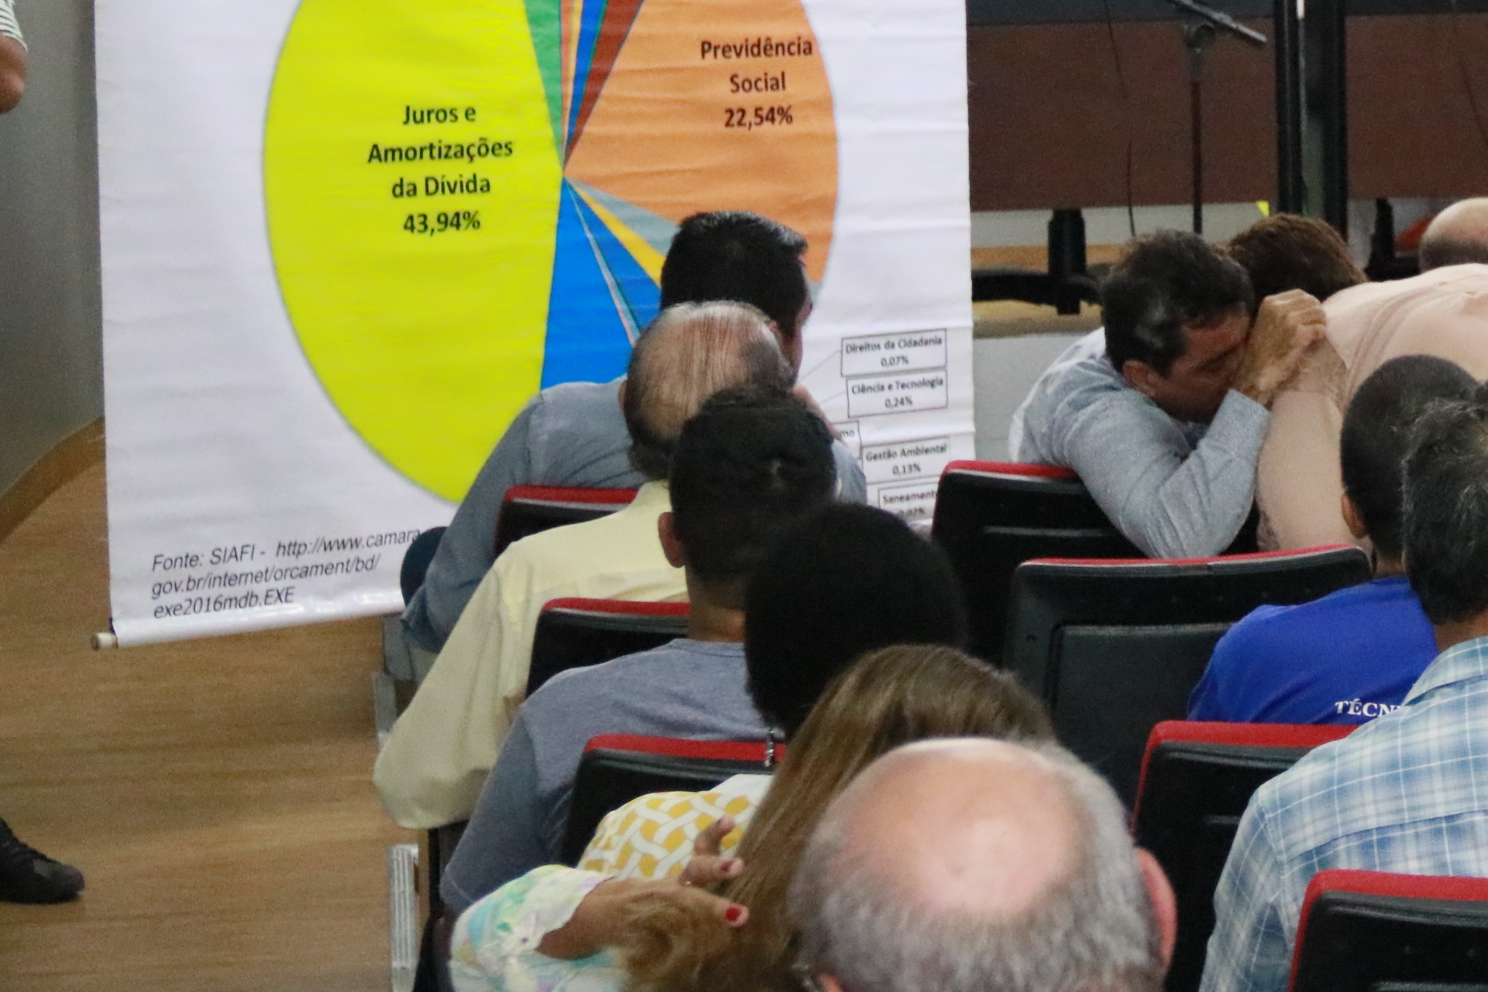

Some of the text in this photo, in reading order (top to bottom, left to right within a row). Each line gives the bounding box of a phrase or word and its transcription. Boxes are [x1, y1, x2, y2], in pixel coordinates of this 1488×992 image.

[700, 36, 813, 60] Previdência
[729, 71, 786, 94] Social
[402, 105, 476, 126] Juros e
[724, 106, 793, 130] 22,54%
[367, 138, 513, 165] Amortizações
[391, 174, 491, 198] da Dívida
[403, 211, 481, 236] 43,94%
[845, 336, 943, 355] Direitos da Cidadania
[880, 355, 910, 367] 0,07%
[851, 377, 944, 395] Ciência e Tecnologia
[885, 395, 913, 409] 0,24%
[865, 443, 947, 462] Gestão Ambiental
[893, 463, 921, 476] 0,13%
[882, 491, 938, 505] Saneament
[152, 553, 204, 573] Fonte:
[209, 544, 256, 566] SIAFI
[151, 553, 381, 599] gov.br/internet/orcament/bd/
[153, 585, 296, 619] exe2016mdb.EXE
